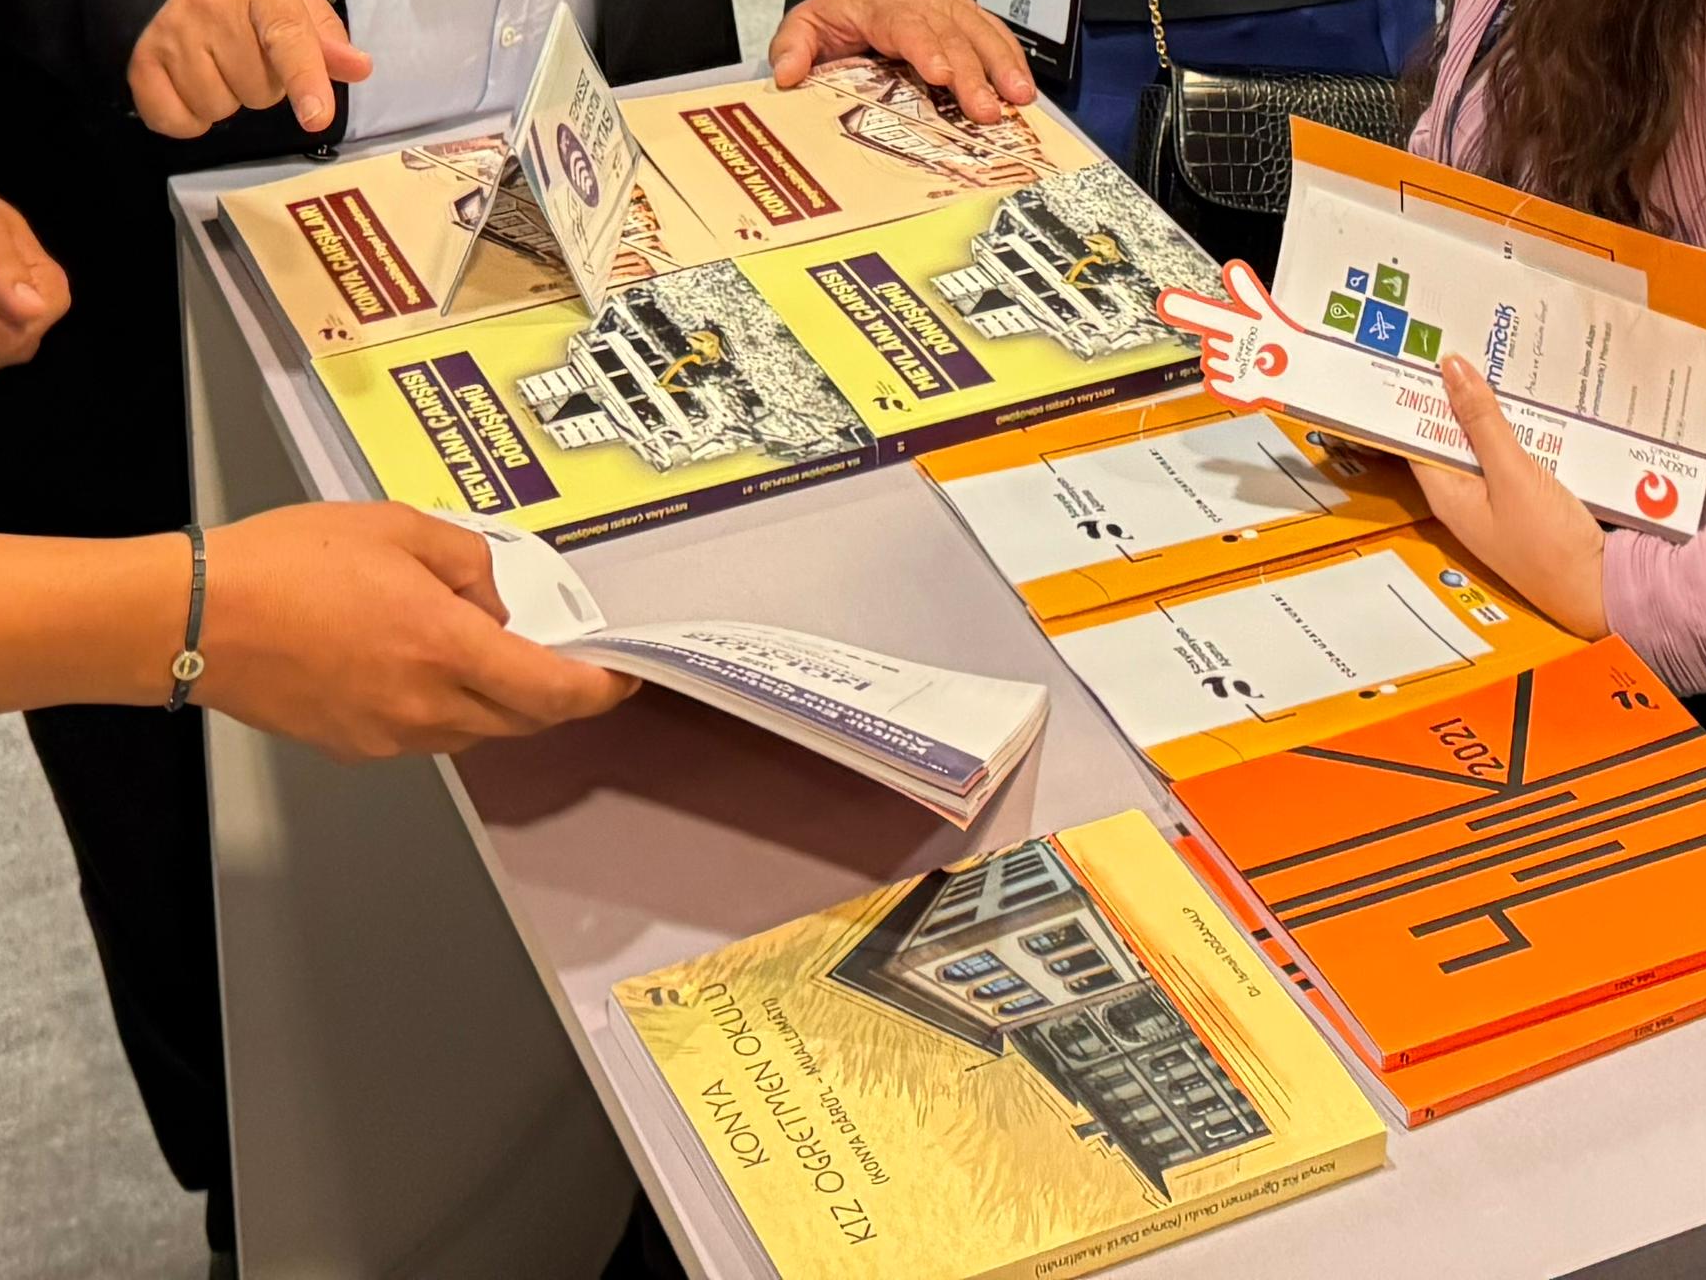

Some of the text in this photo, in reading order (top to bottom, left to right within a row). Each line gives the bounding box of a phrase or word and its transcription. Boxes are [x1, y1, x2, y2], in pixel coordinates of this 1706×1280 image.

[687, 112, 761, 175] ÇARŞILARI
[738, 173, 794, 218] KONYA
[294, 202, 385, 316] KONYA ÇARŞILARI
[816, 269, 940, 392] MEVLÂNA ÇARŞISI
[872, 282, 959, 356] DÖNÜŞÜMÜ
[398, 369, 501, 510] MEVLÂNA ÇARŞISI
[454, 383, 530, 469] DÖNÜŞÜMÜ
[1537, 434, 1563, 456] HEP
[1429, 714, 1507, 777] 2021
[702, 983, 761, 1056] OKULU
[702, 1079, 770, 1169] KONYA
[1302, 1160, 1336, 1180] Konya
[830, 1199, 877, 1245] KIZ
